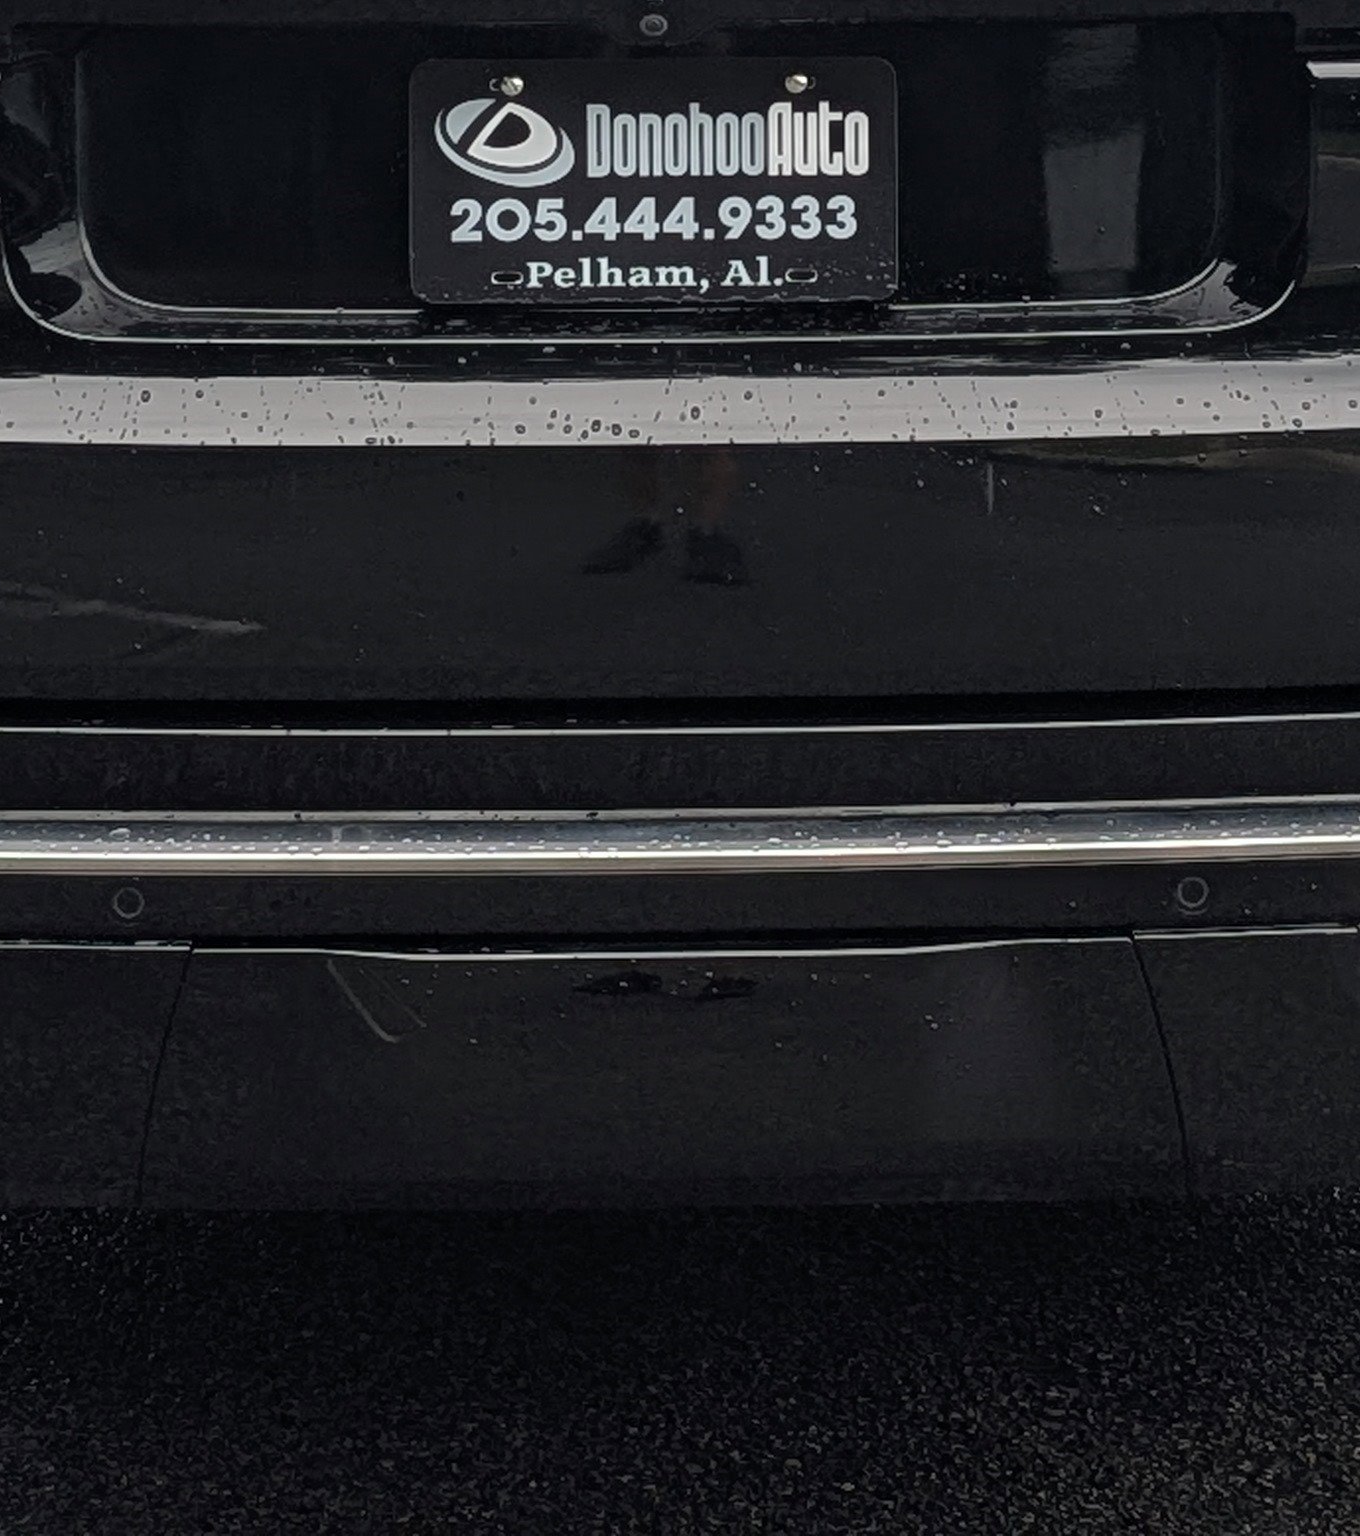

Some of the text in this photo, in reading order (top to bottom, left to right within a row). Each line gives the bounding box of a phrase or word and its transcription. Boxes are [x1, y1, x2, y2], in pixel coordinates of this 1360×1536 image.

[585, 100, 870, 178] DonohooAuto
[449, 194, 858, 243] 205.444.9333
[525, 255, 784, 293] Pelham, Al.
